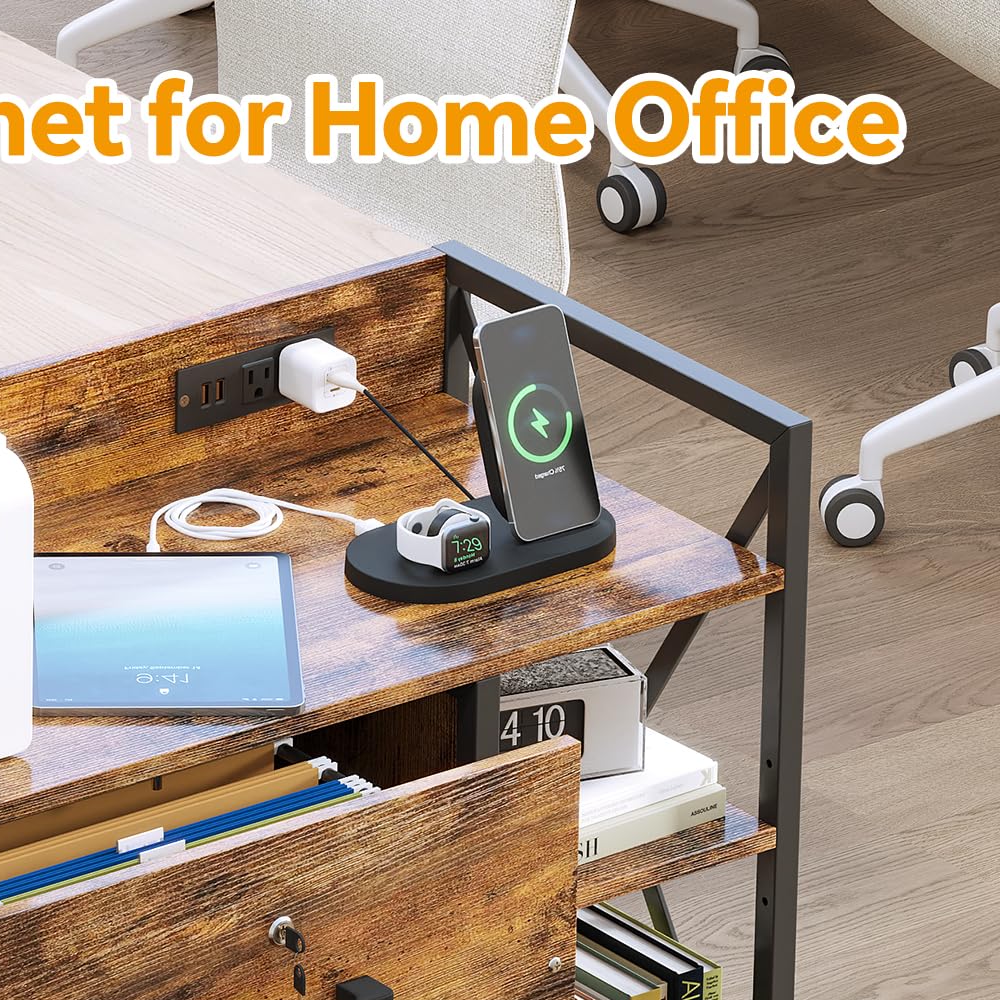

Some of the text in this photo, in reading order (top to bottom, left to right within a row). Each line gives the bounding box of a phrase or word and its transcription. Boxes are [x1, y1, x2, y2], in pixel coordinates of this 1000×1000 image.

[450, 537, 483, 554] 7:29
[532, 704, 566, 742] 10
[690, 803, 718, 817] ASSOULINE
